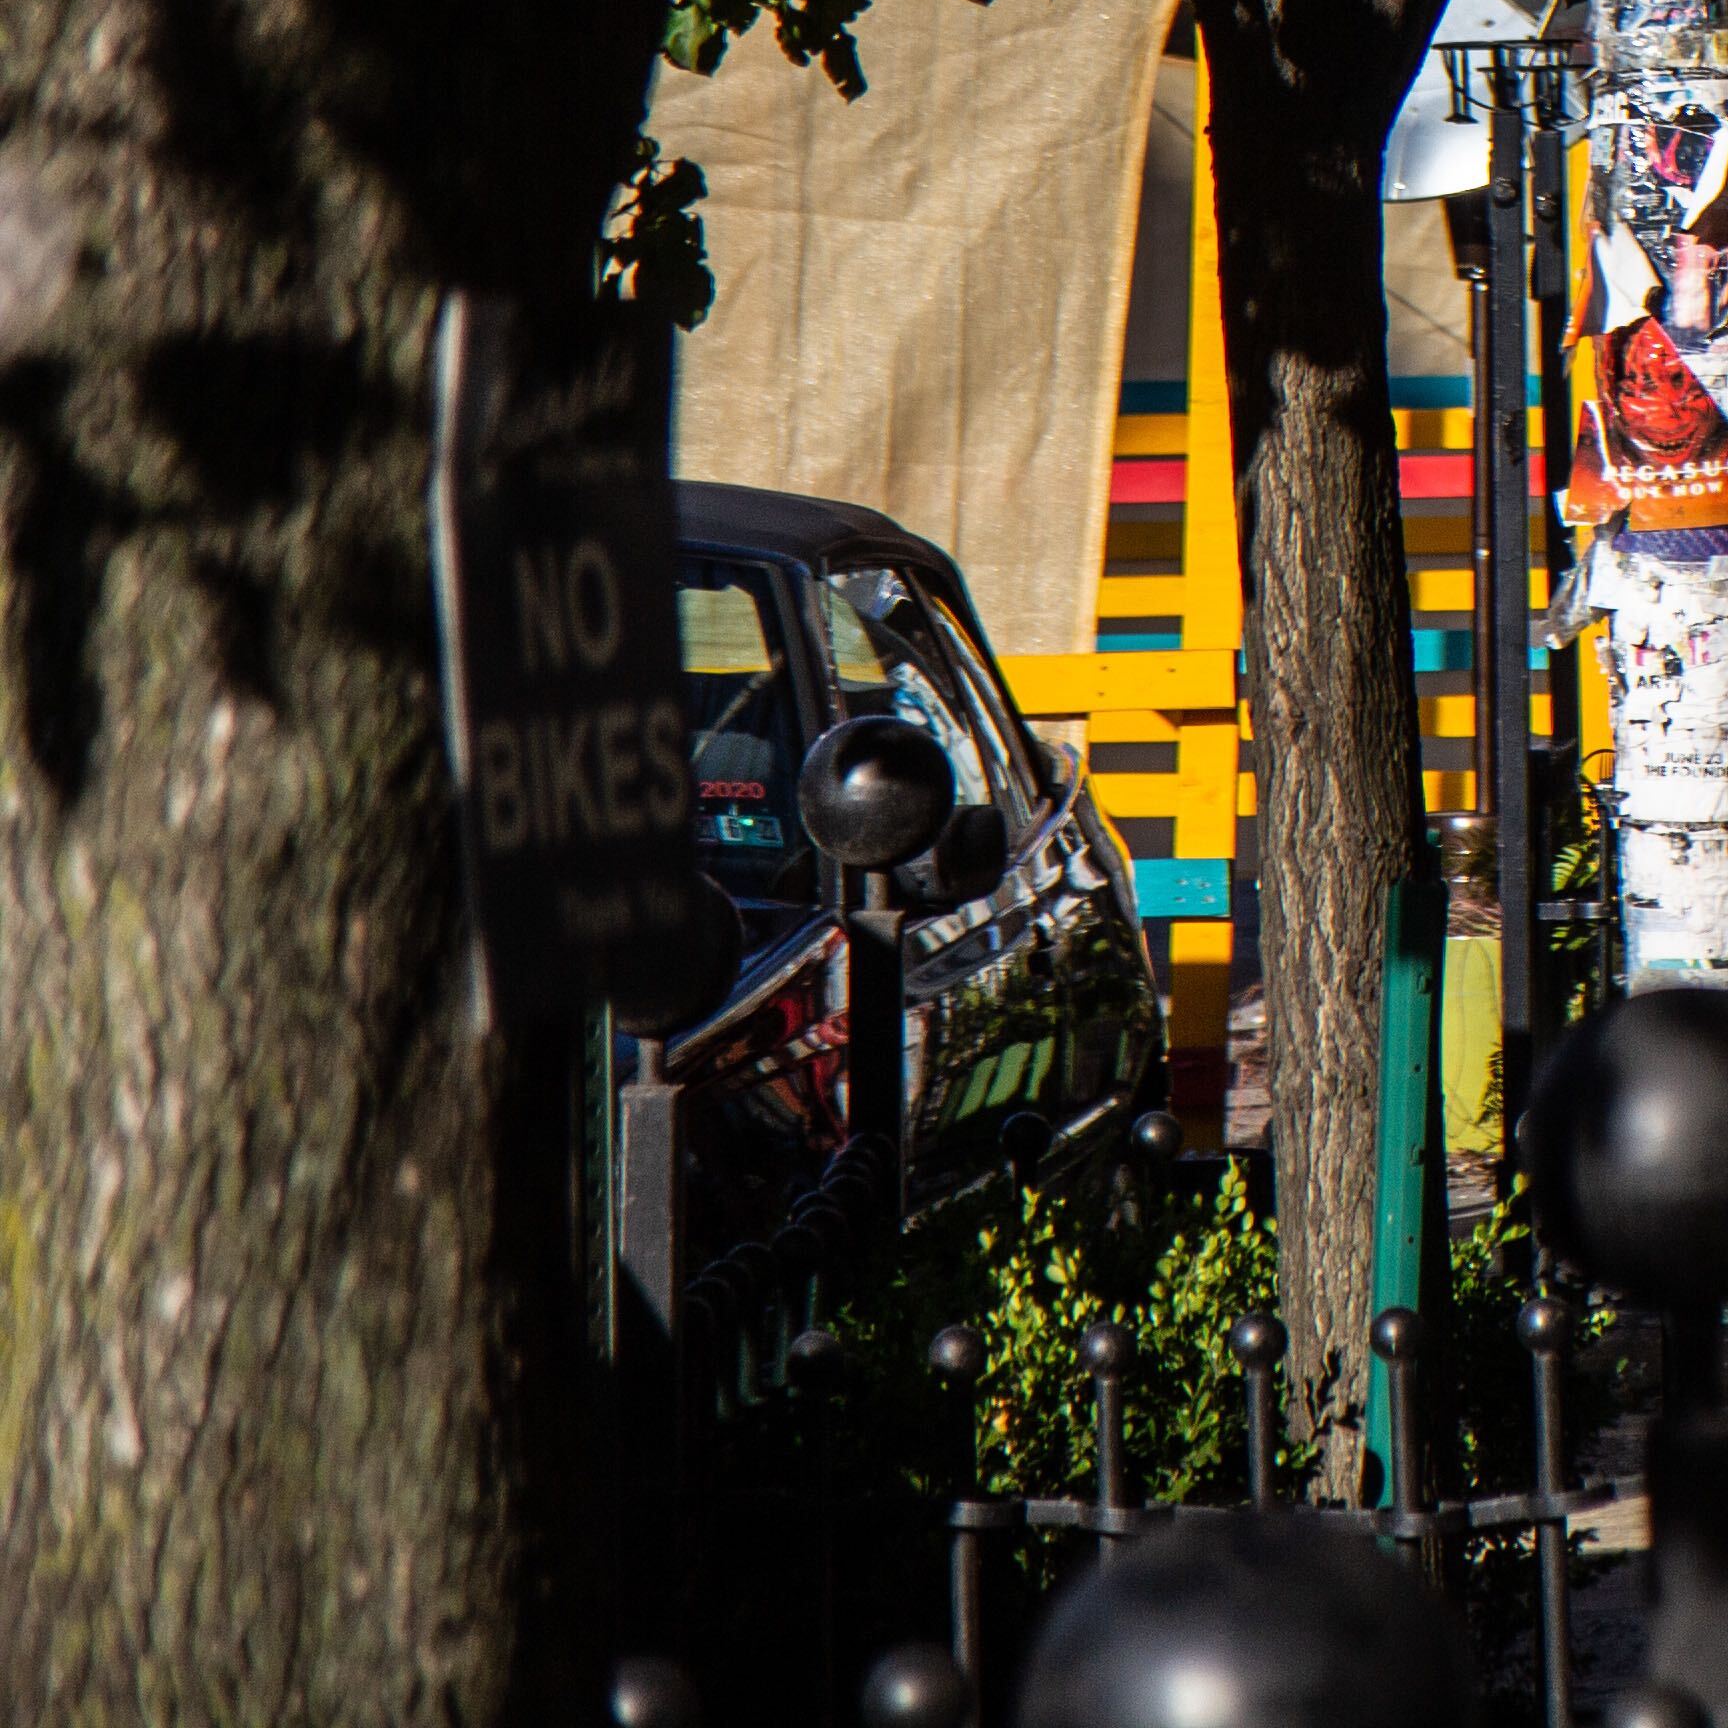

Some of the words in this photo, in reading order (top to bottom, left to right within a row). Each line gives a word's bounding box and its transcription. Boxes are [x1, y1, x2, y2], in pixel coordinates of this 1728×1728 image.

[1671, 480, 1724, 498] NOW
[513, 534, 622, 670] NO
[477, 697, 691, 854] BIKES
